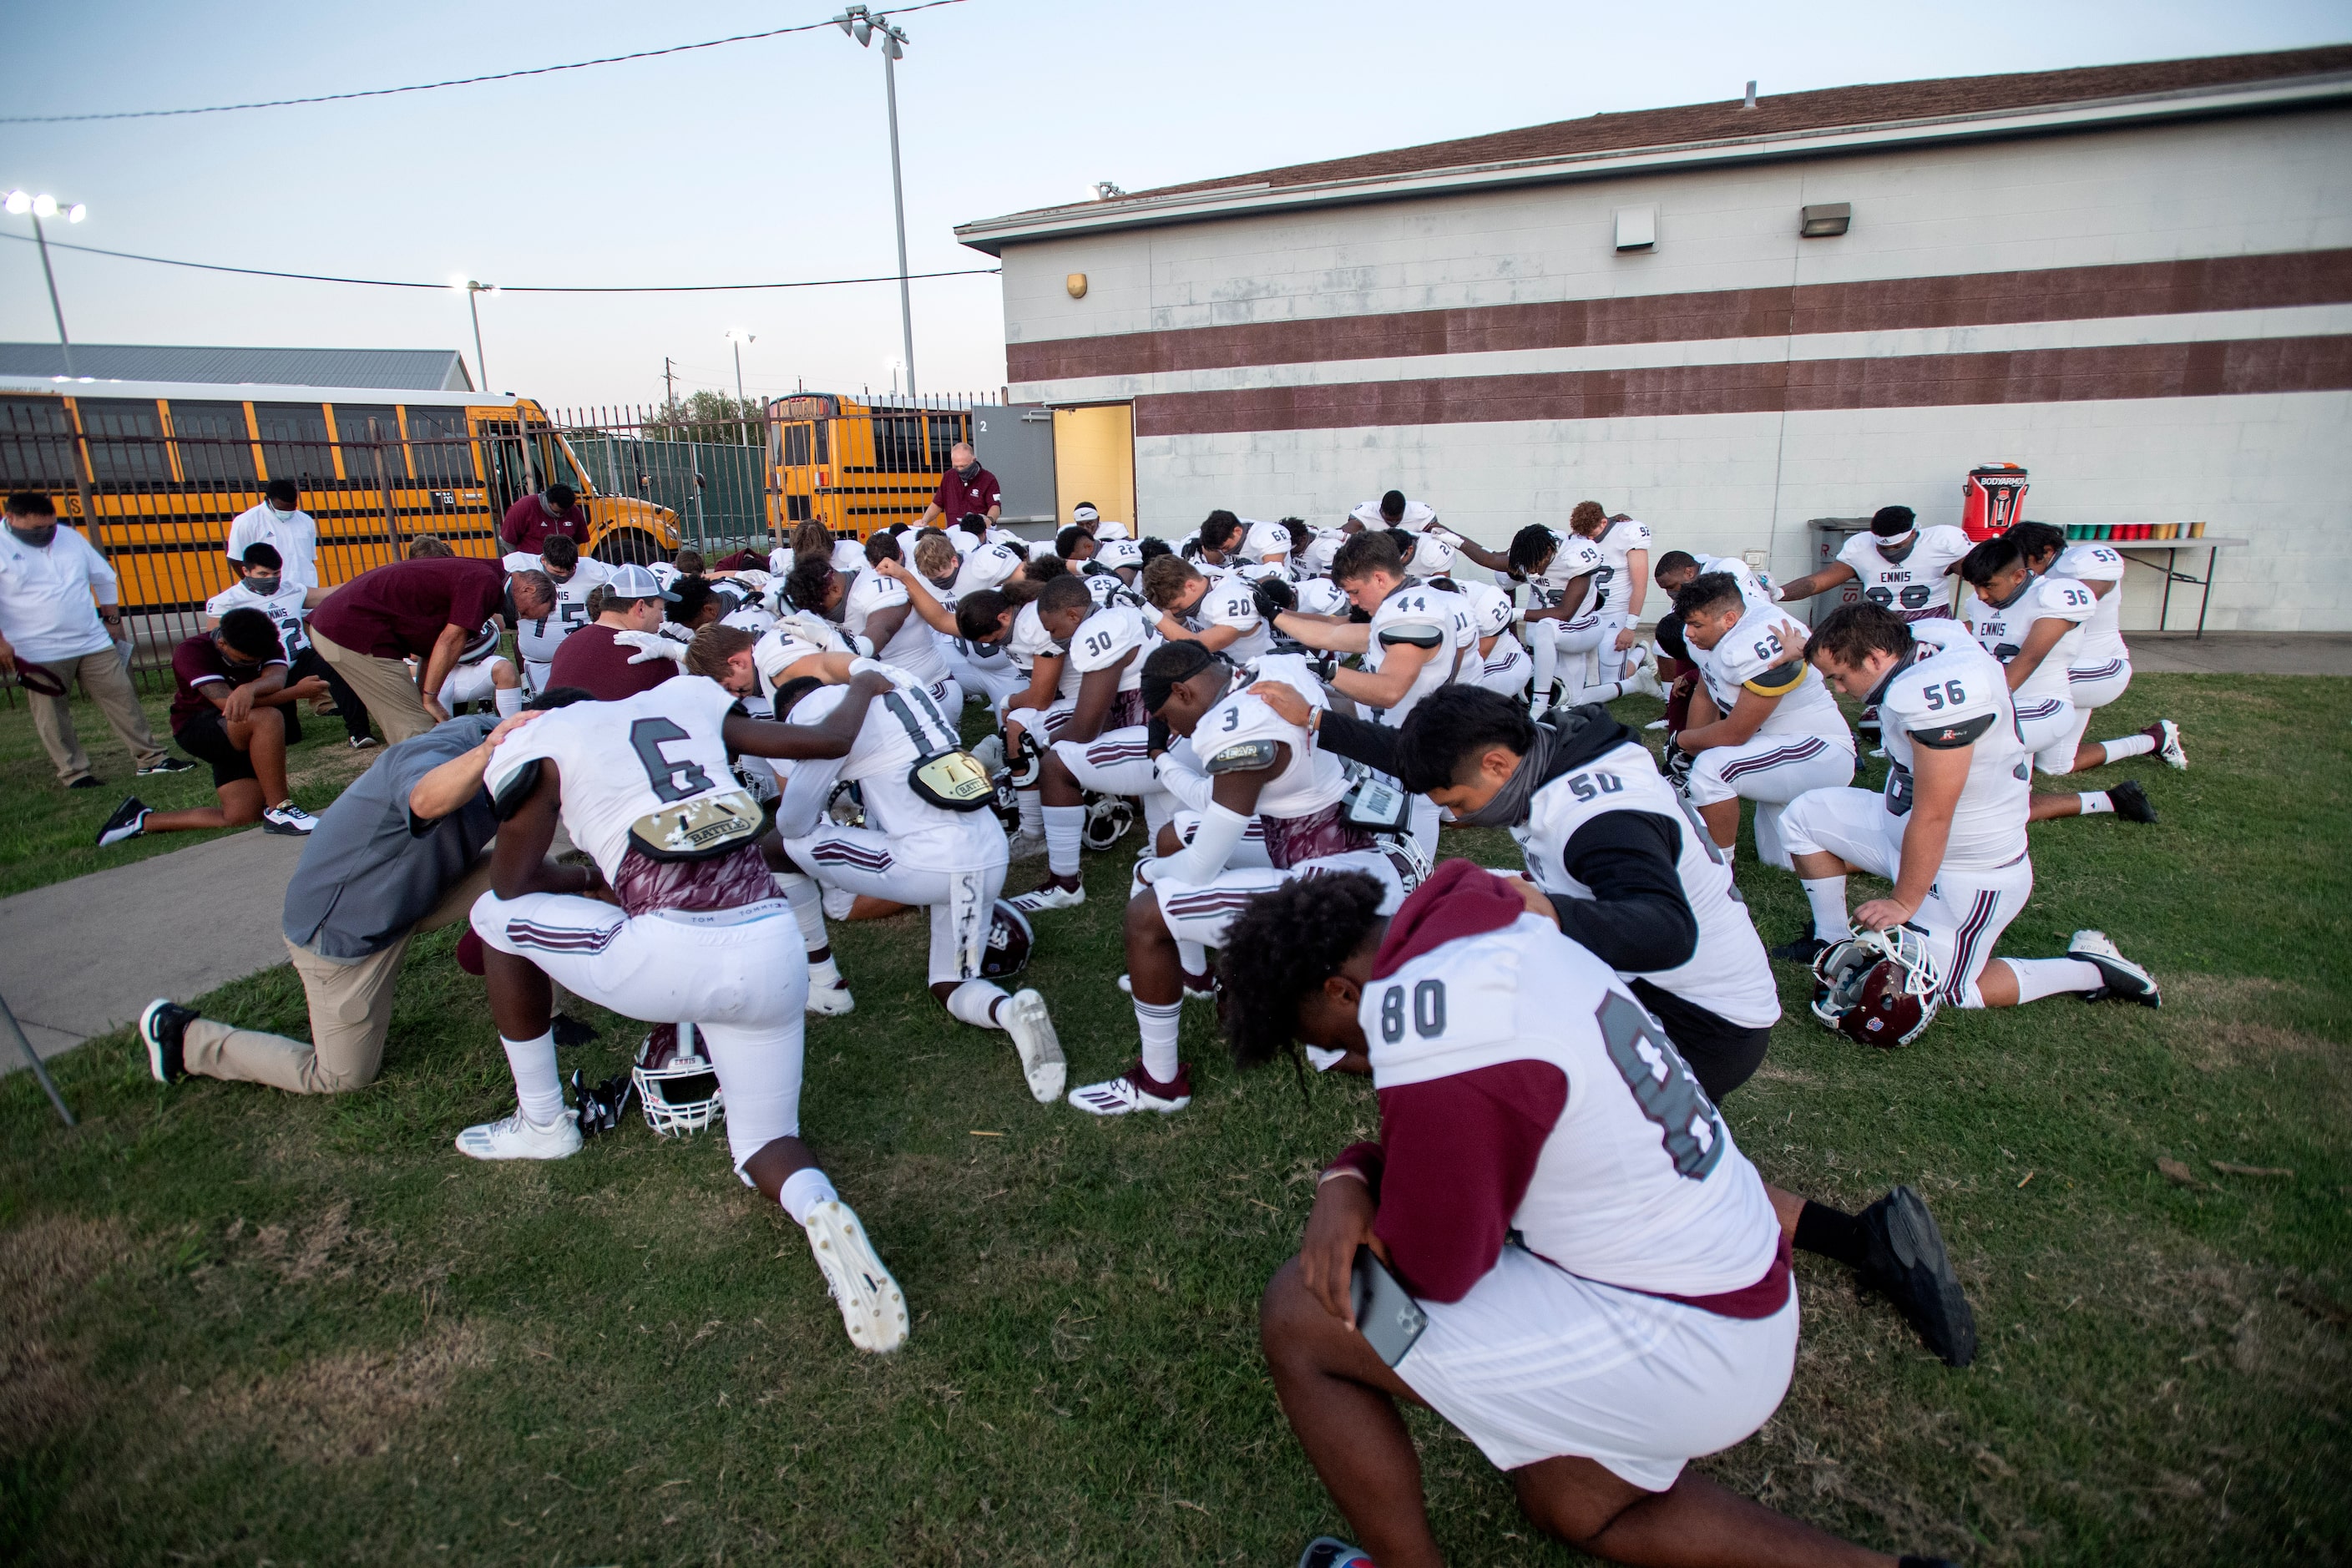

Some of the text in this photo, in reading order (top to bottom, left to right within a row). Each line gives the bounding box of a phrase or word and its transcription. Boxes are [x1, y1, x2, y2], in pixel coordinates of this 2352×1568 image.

[979, 420, 988, 432] 2
[1271, 530, 1287, 542] 66
[1117, 544, 1136, 556] 22
[1580, 548, 1598, 564] 99
[2092, 549, 2117, 563] 55
[873, 577, 894, 593] 77
[1092, 579, 1112, 591] 25
[1880, 571, 1912, 583] ENNIS
[1397, 596, 1426, 613] 44
[2063, 589, 2089, 606] 36
[1227, 598, 1251, 617] 20
[1491, 600, 1510, 623] 23
[1980, 622, 2007, 637] ENNIS
[1085, 630, 1112, 657] 30
[1753, 635, 1783, 660] 62
[1923, 679, 1966, 711] 56
[883, 685, 959, 755] 11
[1222, 705, 1239, 732] 3
[630, 716, 716, 804] 6
[1567, 772, 1625, 803] 50
[1367, 786, 1393, 816] DOUGLAS
[690, 820, 746, 843] BATTLE
[1382, 979, 1448, 1044] 80
[675, 1057, 695, 1066] ENNIS
